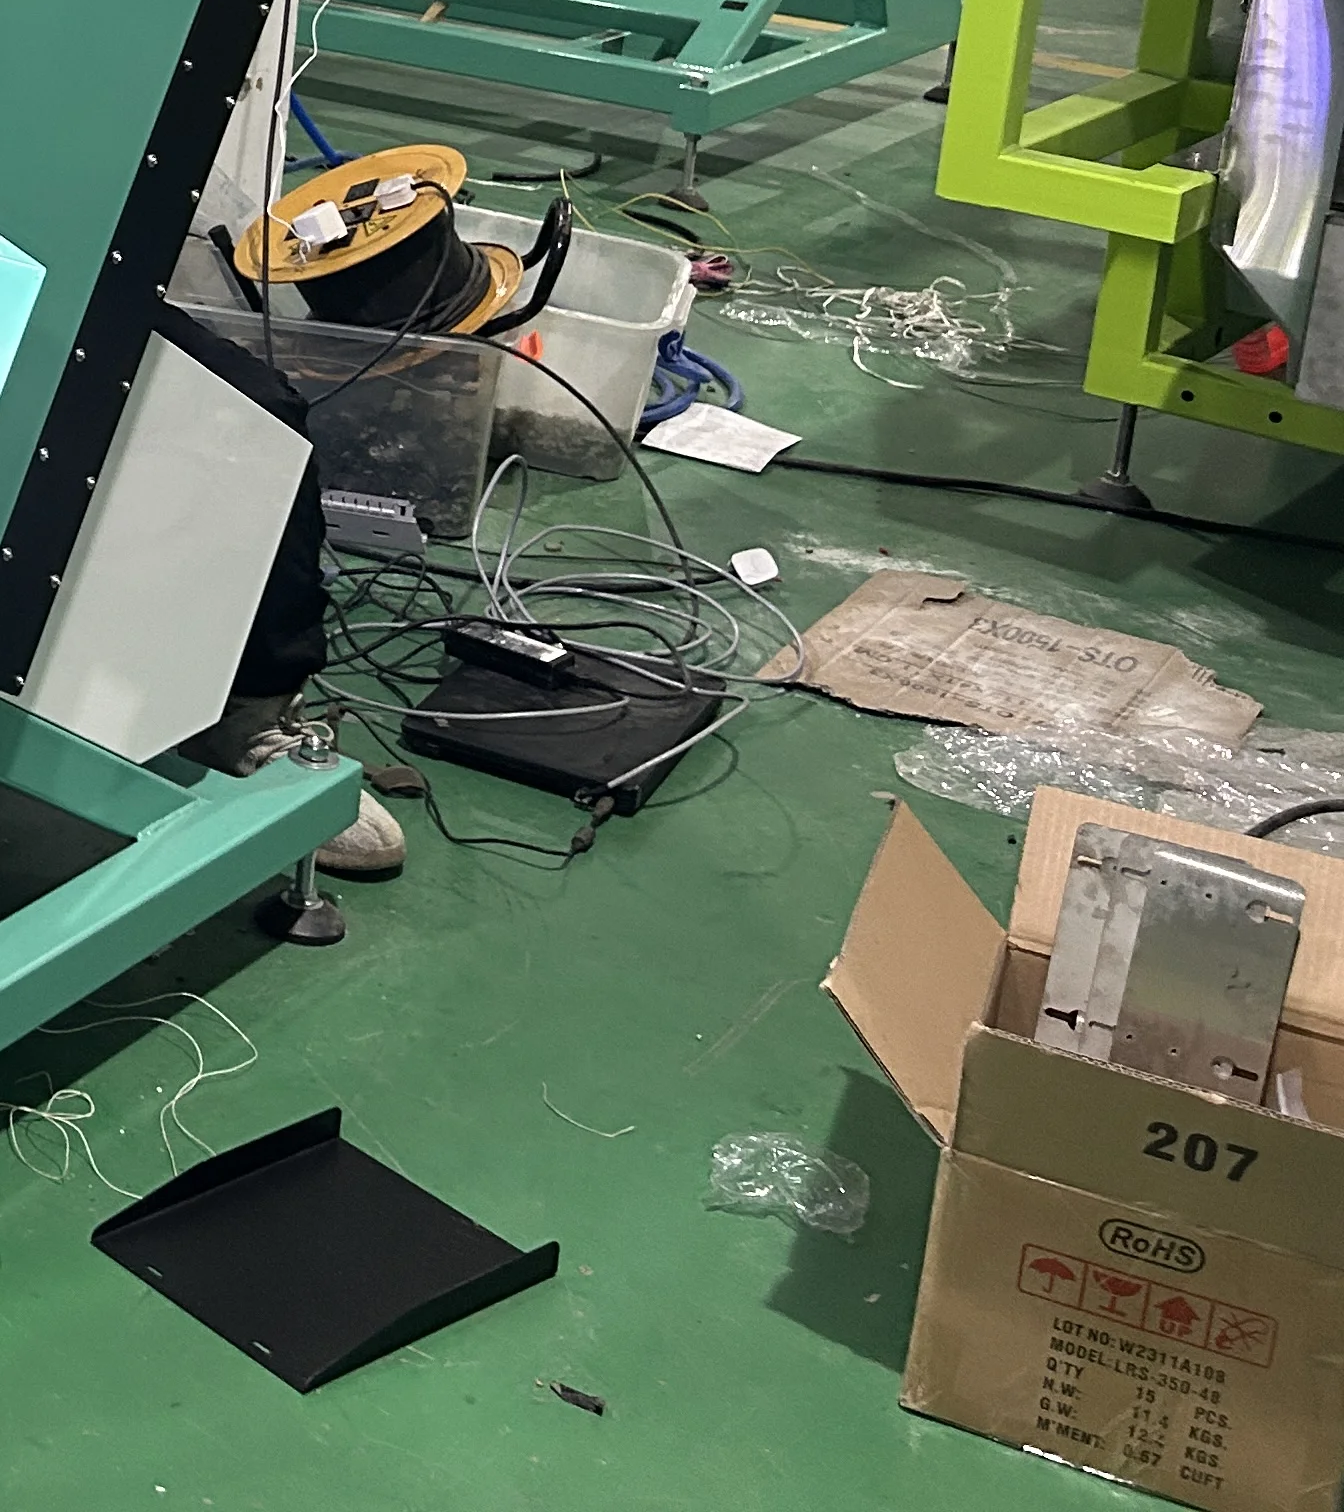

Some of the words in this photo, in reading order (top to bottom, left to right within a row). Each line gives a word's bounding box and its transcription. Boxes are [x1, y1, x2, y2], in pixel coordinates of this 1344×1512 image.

[1142, 1121, 1259, 1182] 207
[1109, 1226, 1197, 1266] RoHS
[1053, 1317, 1084, 1336] LOT
[1159, 1319, 1193, 1337] UP
[1136, 1386, 1156, 1404] 15
[1180, 1465, 1225, 1491] CUFT
